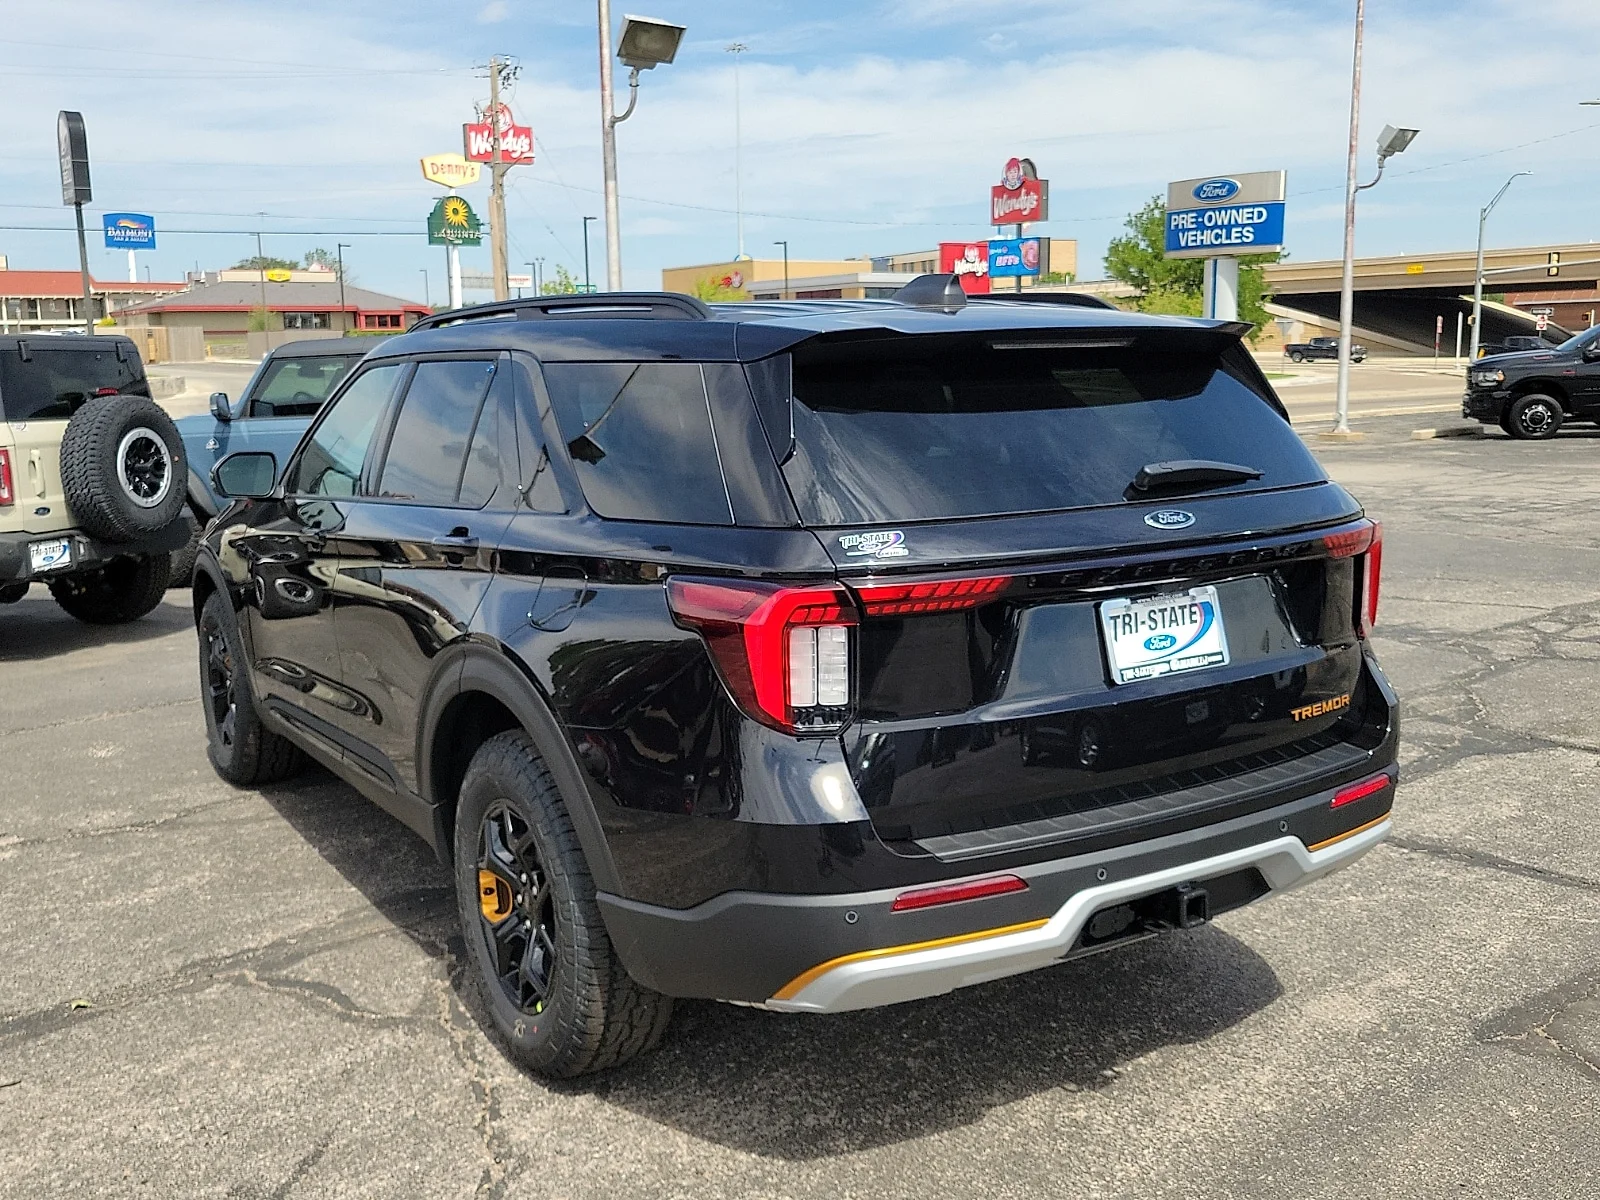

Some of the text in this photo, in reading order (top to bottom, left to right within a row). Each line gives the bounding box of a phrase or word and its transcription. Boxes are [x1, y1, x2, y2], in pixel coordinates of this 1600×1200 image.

[470, 129, 530, 158] Wedy's
[430, 162, 475, 178] Denny's
[1200, 183, 1229, 198] Ford
[993, 188, 1038, 219] Wendy's
[1170, 207, 1268, 230] PRE-OWNED
[1178, 226, 1255, 247] VEHICLES
[1158, 512, 1186, 524] Ford
[839, 532, 892, 549] TRI-STATE
[1109, 603, 1198, 642] TRI-STATE
[1149, 636, 1171, 649] Ford
[1291, 693, 1350, 722] TREMOR
